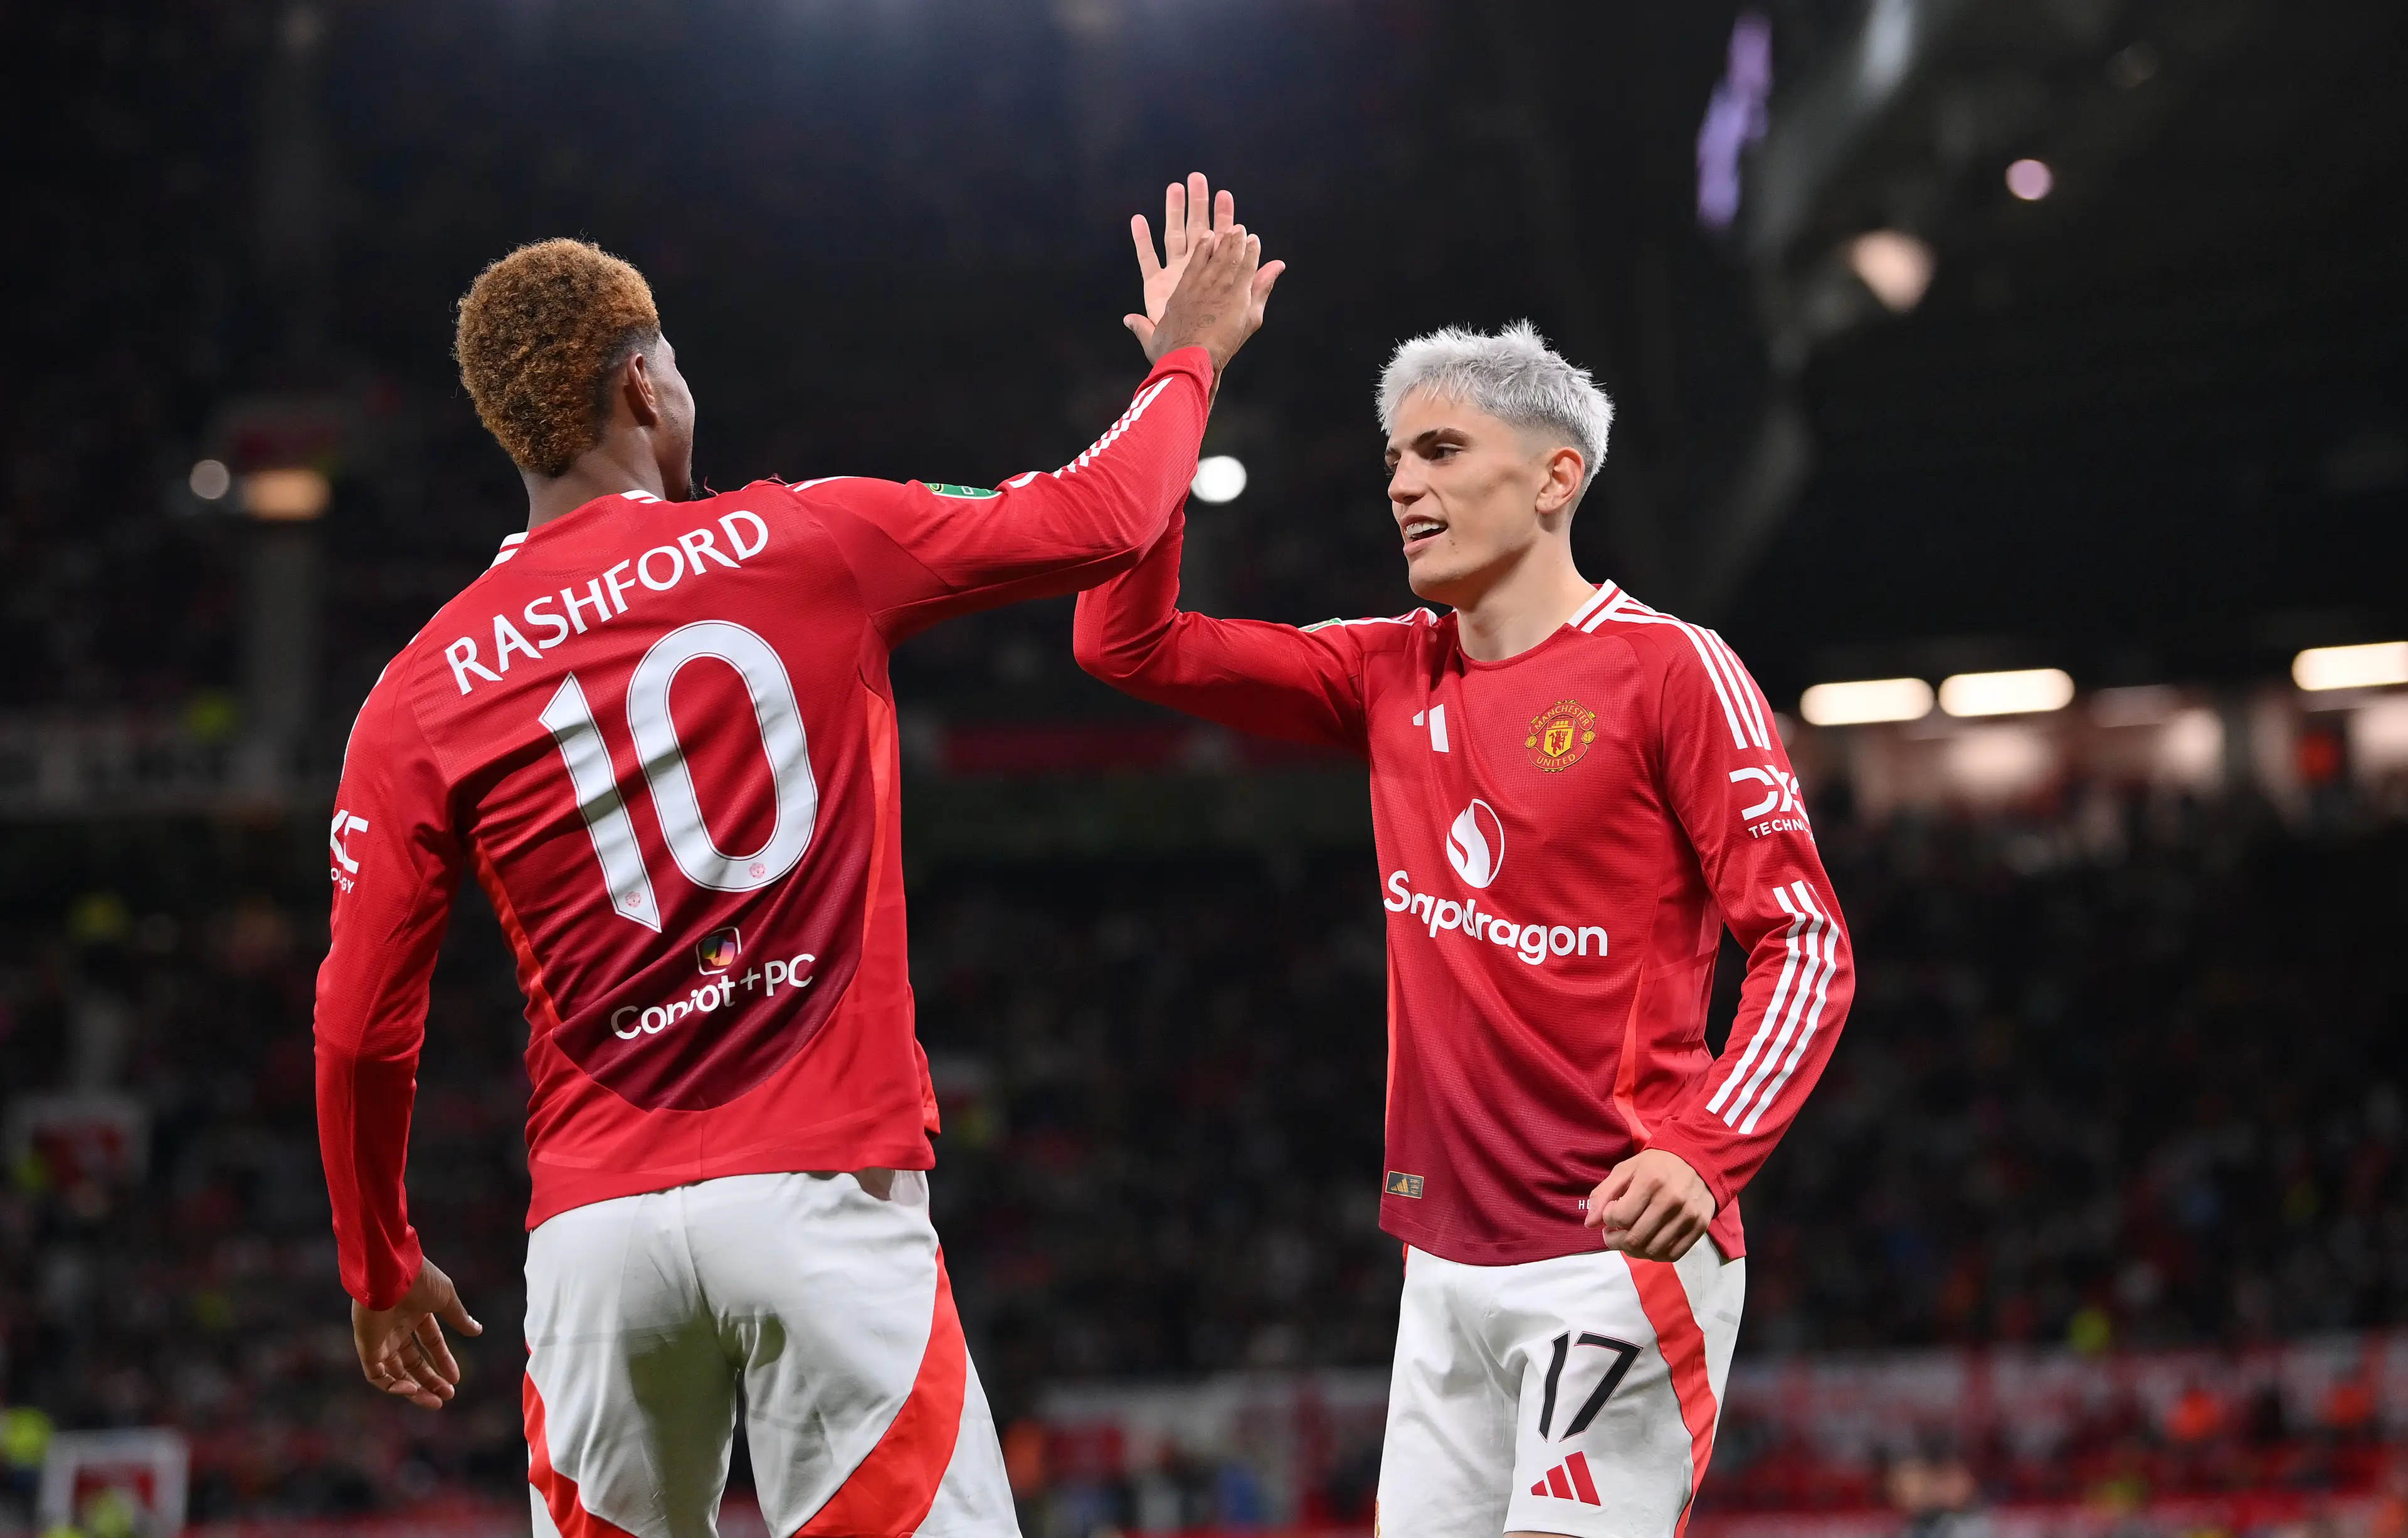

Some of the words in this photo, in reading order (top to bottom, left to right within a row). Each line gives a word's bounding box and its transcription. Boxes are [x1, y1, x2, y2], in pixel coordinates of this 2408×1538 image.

[444, 510, 769, 696] RASHFORD
[1534, 705, 1590, 729] MANCHESTER
[539, 619, 818, 933] 10
[1536, 754, 1576, 767] UNITED
[1748, 818, 1815, 844] TECHN
[1538, 1330, 1644, 1443] 17
